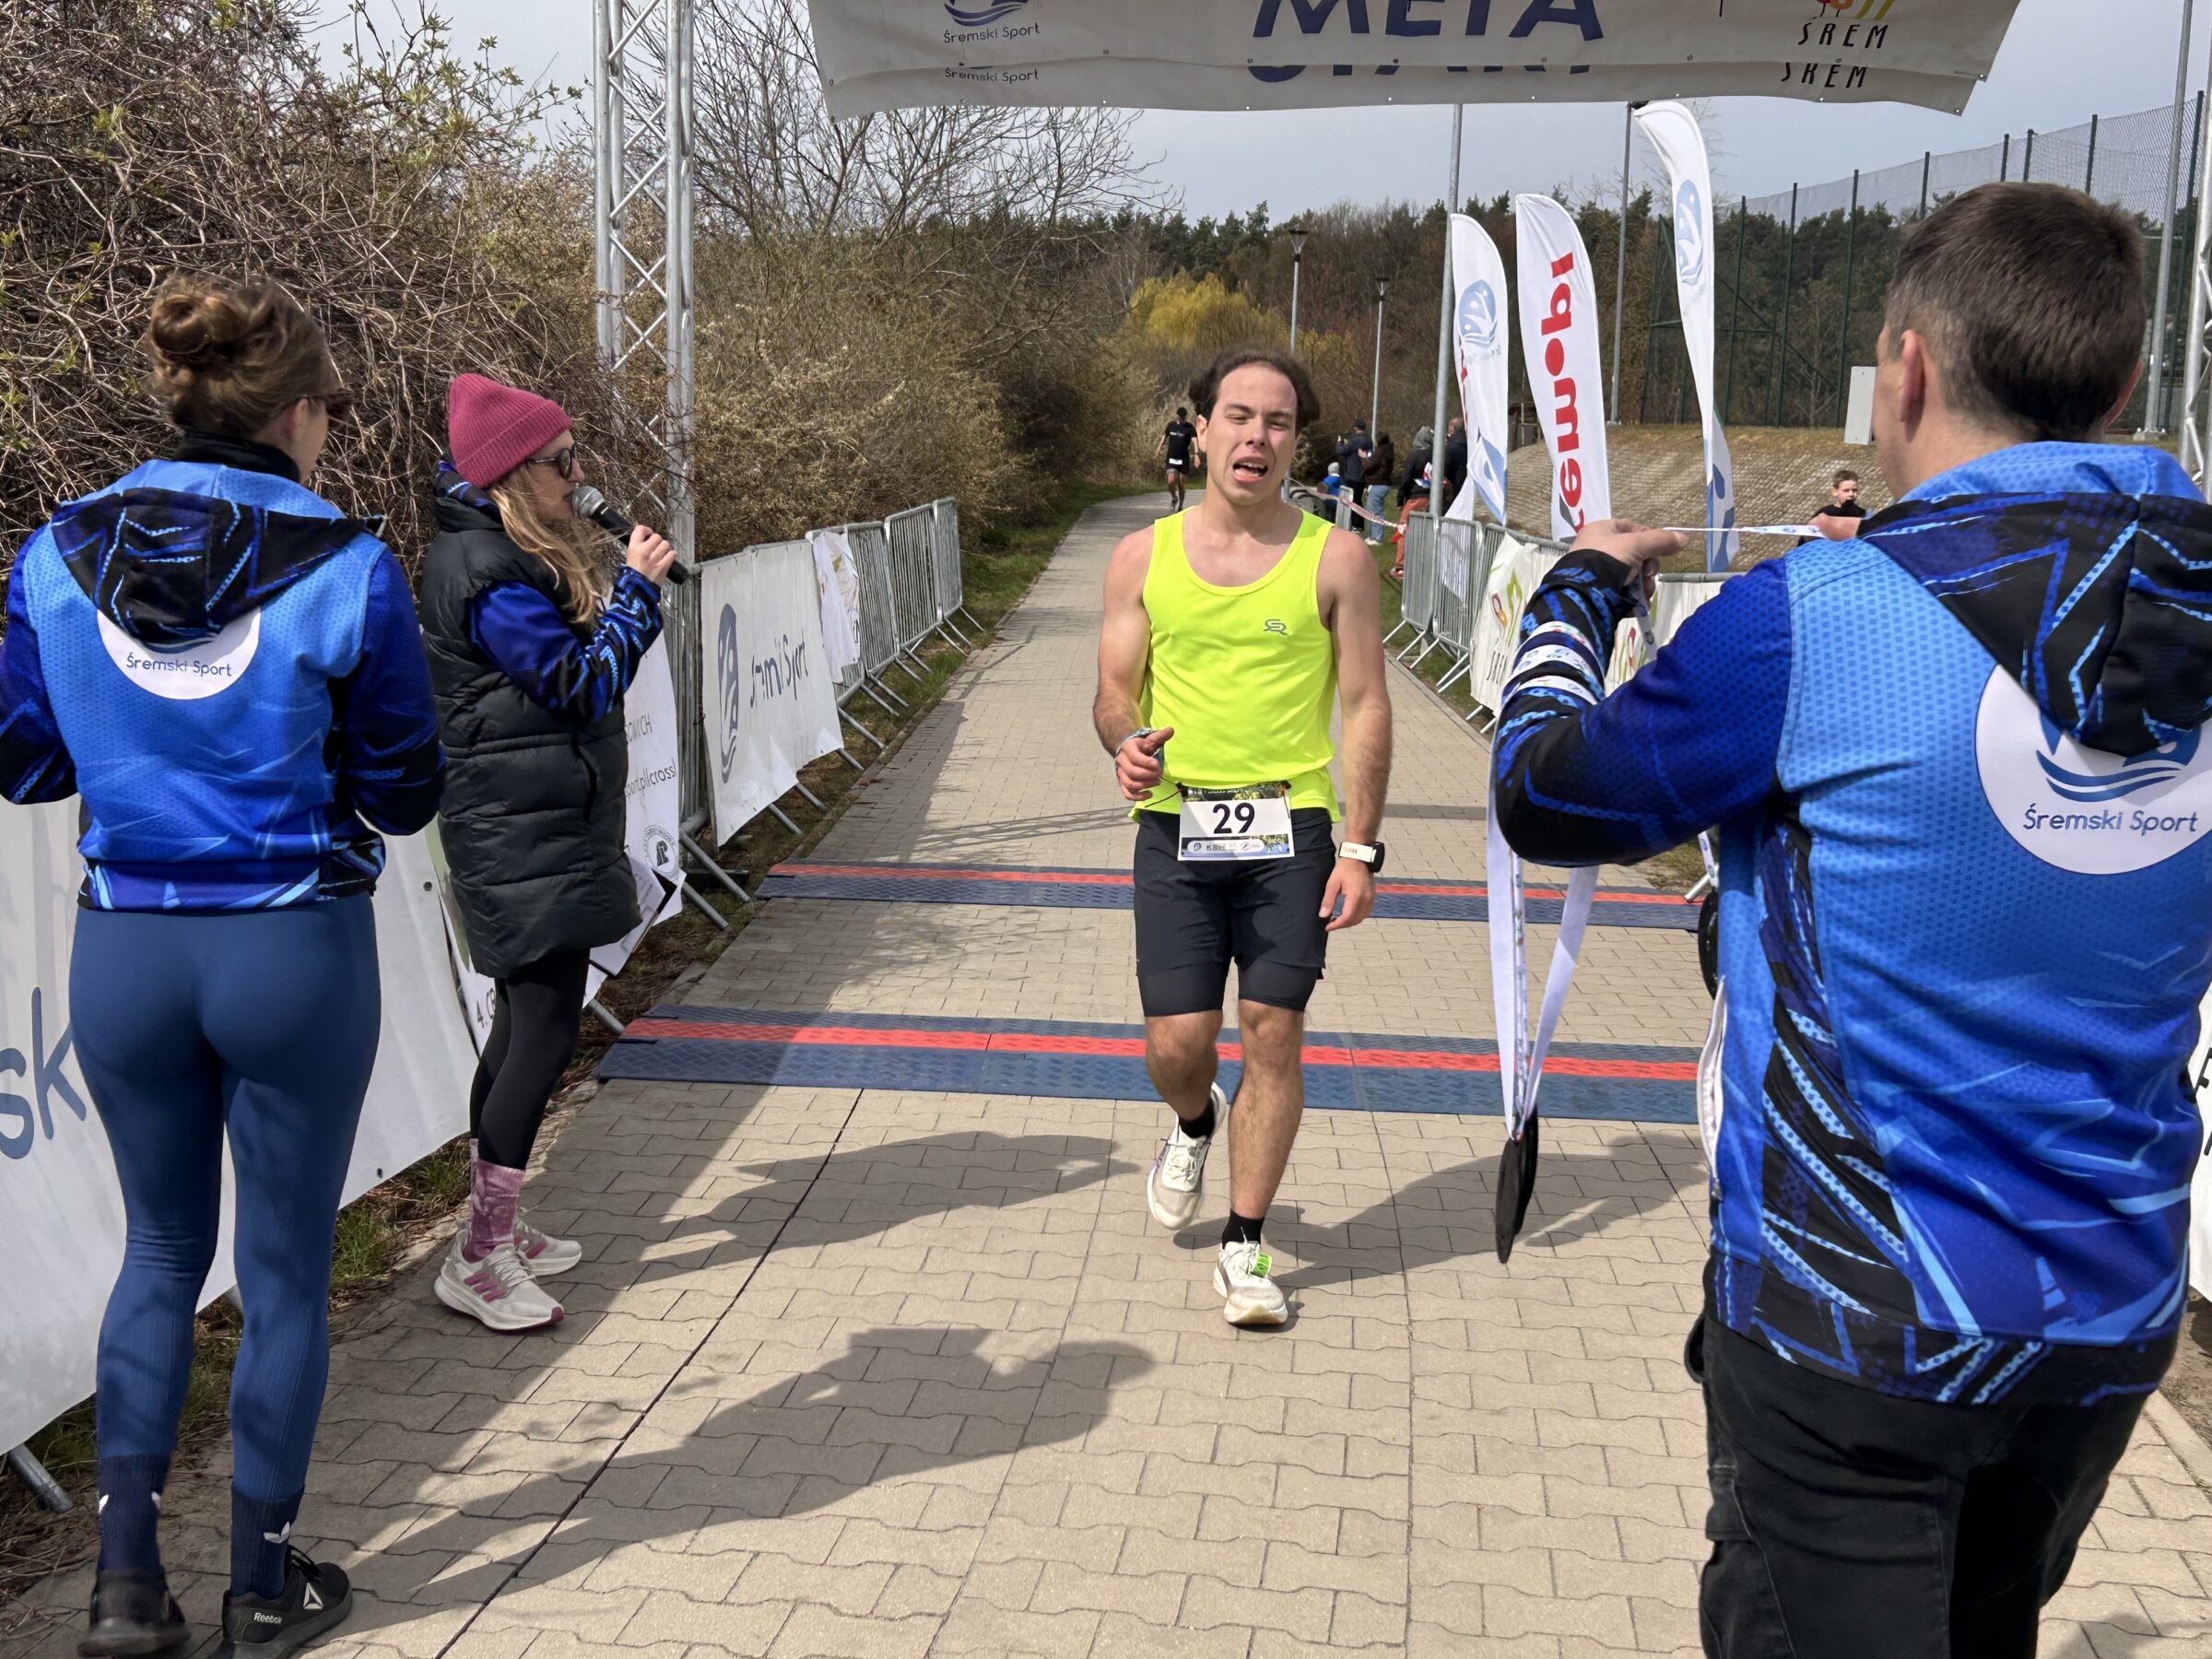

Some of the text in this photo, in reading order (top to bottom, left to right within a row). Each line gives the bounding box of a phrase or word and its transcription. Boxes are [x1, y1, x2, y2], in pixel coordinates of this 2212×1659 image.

[943, 22, 1041, 43] Śremski Sport
[1003, 68, 1039, 84] Sport
[126, 653, 231, 677] Śremski Sport
[1212, 802, 1255, 834] 29
[2023, 803, 2198, 836] Śremski Sport
